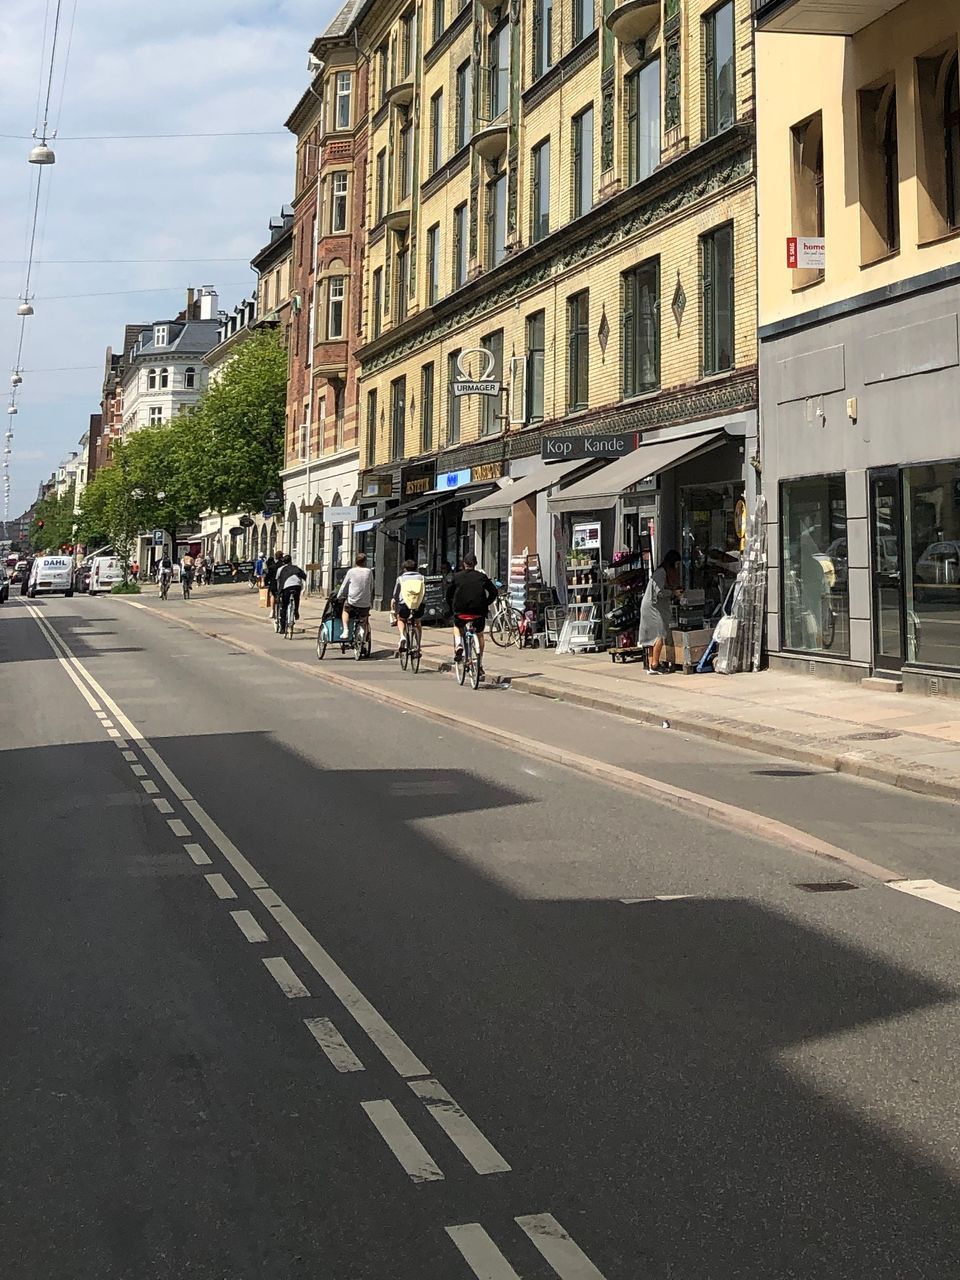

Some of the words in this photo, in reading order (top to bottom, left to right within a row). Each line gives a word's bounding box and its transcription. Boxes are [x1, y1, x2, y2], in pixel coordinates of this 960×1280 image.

[803, 242, 825, 250] home
[456, 384, 496, 392] URMAGER
[547, 439, 572, 456] Kop
[584, 438, 624, 452] Kande
[155, 531, 162, 540] P
[43, 559, 67, 567] DAHL
